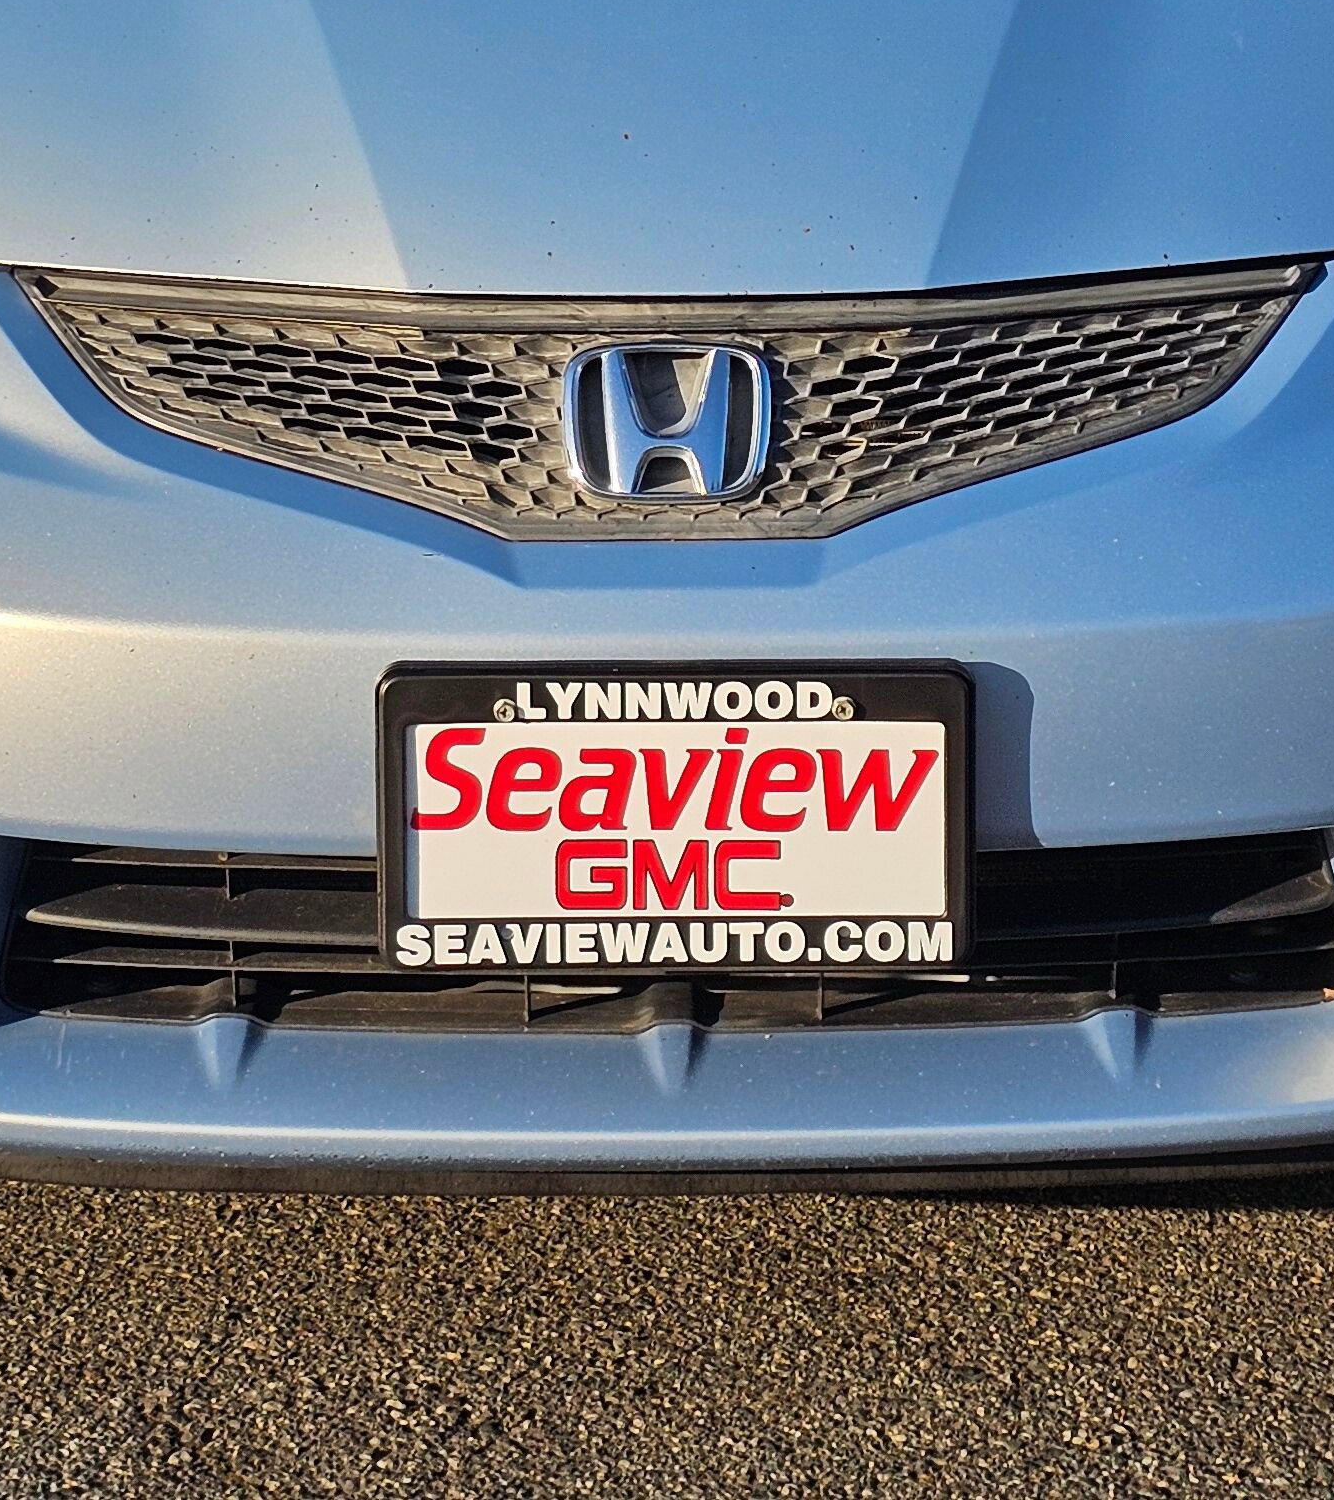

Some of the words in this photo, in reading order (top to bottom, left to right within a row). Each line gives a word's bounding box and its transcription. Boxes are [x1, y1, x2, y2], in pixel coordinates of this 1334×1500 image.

[517, 680, 834, 720] LYNNWOOD
[411, 727, 939, 832] Seaview
[555, 839, 783, 911] GMC
[396, 920, 954, 967] SEAVIEWAUTO.COM
